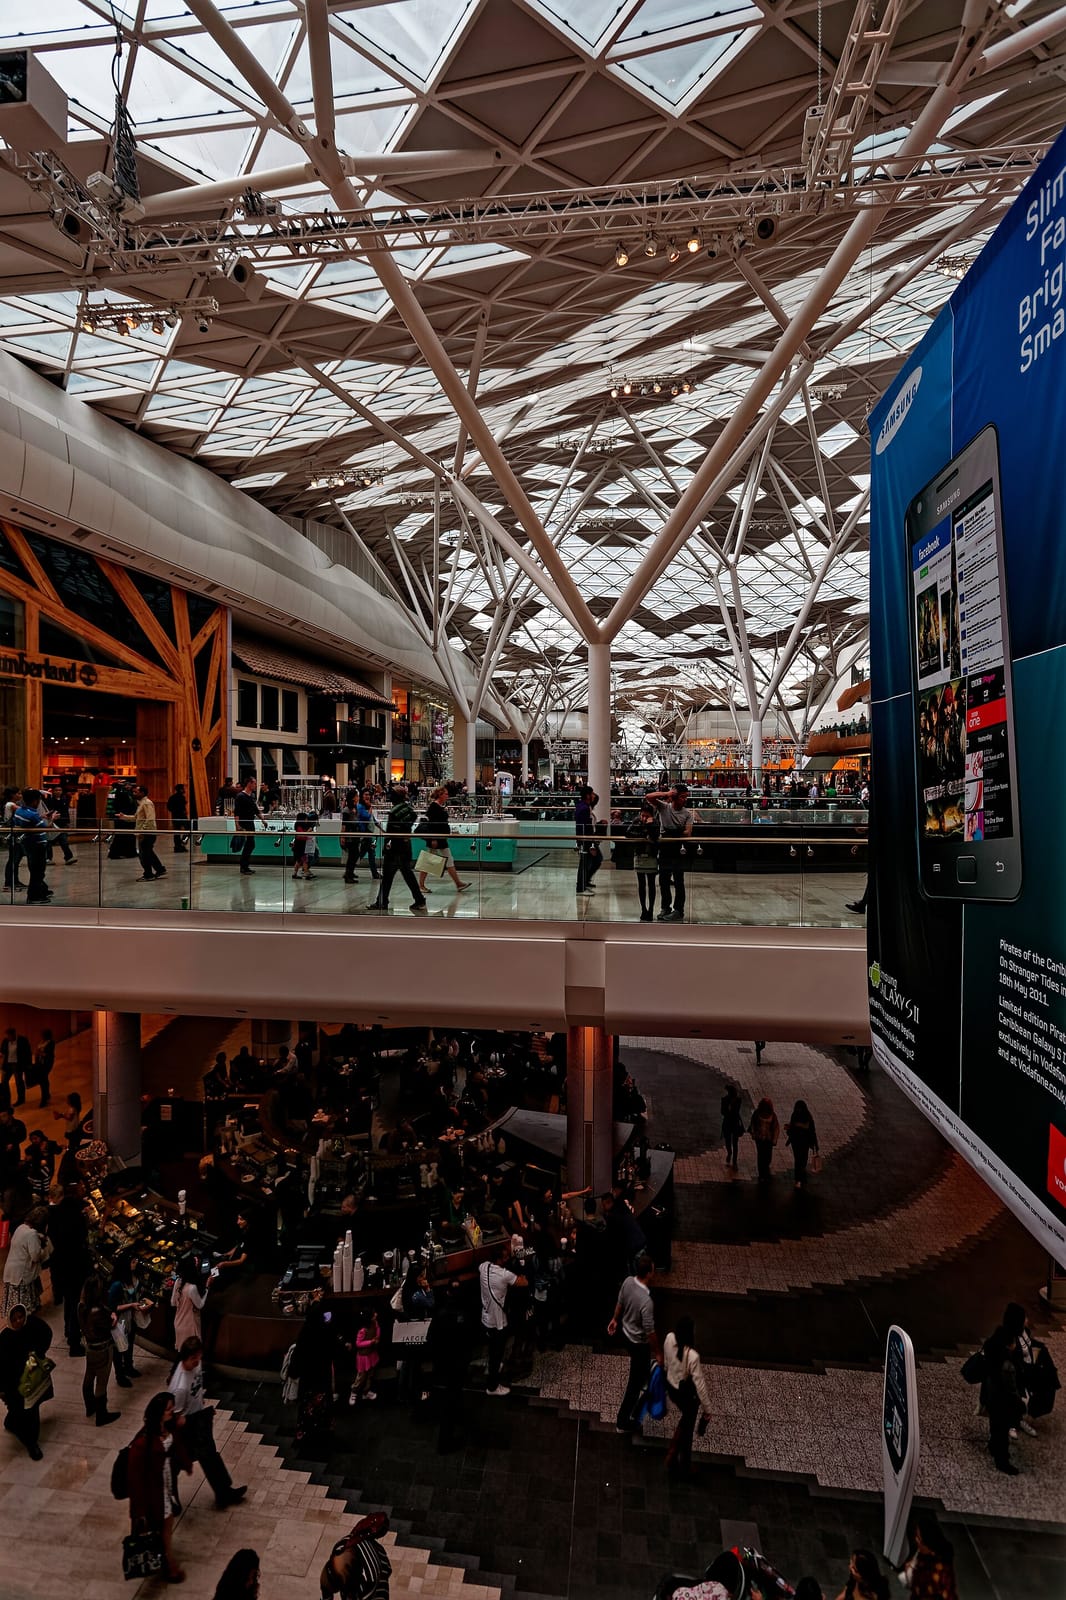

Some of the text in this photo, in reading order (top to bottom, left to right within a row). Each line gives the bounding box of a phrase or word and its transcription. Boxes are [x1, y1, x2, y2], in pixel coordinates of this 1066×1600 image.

[1020, 307, 1064, 373] Sma
[881, 383, 917, 440] SAMSUNG
[936, 488, 960, 515] SAMSUNG
[1000, 939, 1022, 958] Pirates
[1023, 949, 1032, 961] of
[1032, 952, 1045, 967] the
[1000, 955, 1008, 969] On
[1009, 960, 1040, 983] Stranger
[1040, 973, 1060, 993] Tides
[1000, 972, 1013, 989] 18th
[1014, 979, 1028, 999] May
[999, 994, 1022, 1017] Limited
[1023, 1011, 1049, 1032] edition
[999, 1011, 1032, 1041] Caribbean
[1033, 1032, 1056, 1060] Galaxy
[1057, 1047, 1062, 1061] S
[999, 1030, 1032, 1062] exclusively
[1032, 1050, 1040, 1064] in
[998, 1046, 1010, 1061] and
[1010, 1056, 1018, 1067] at
